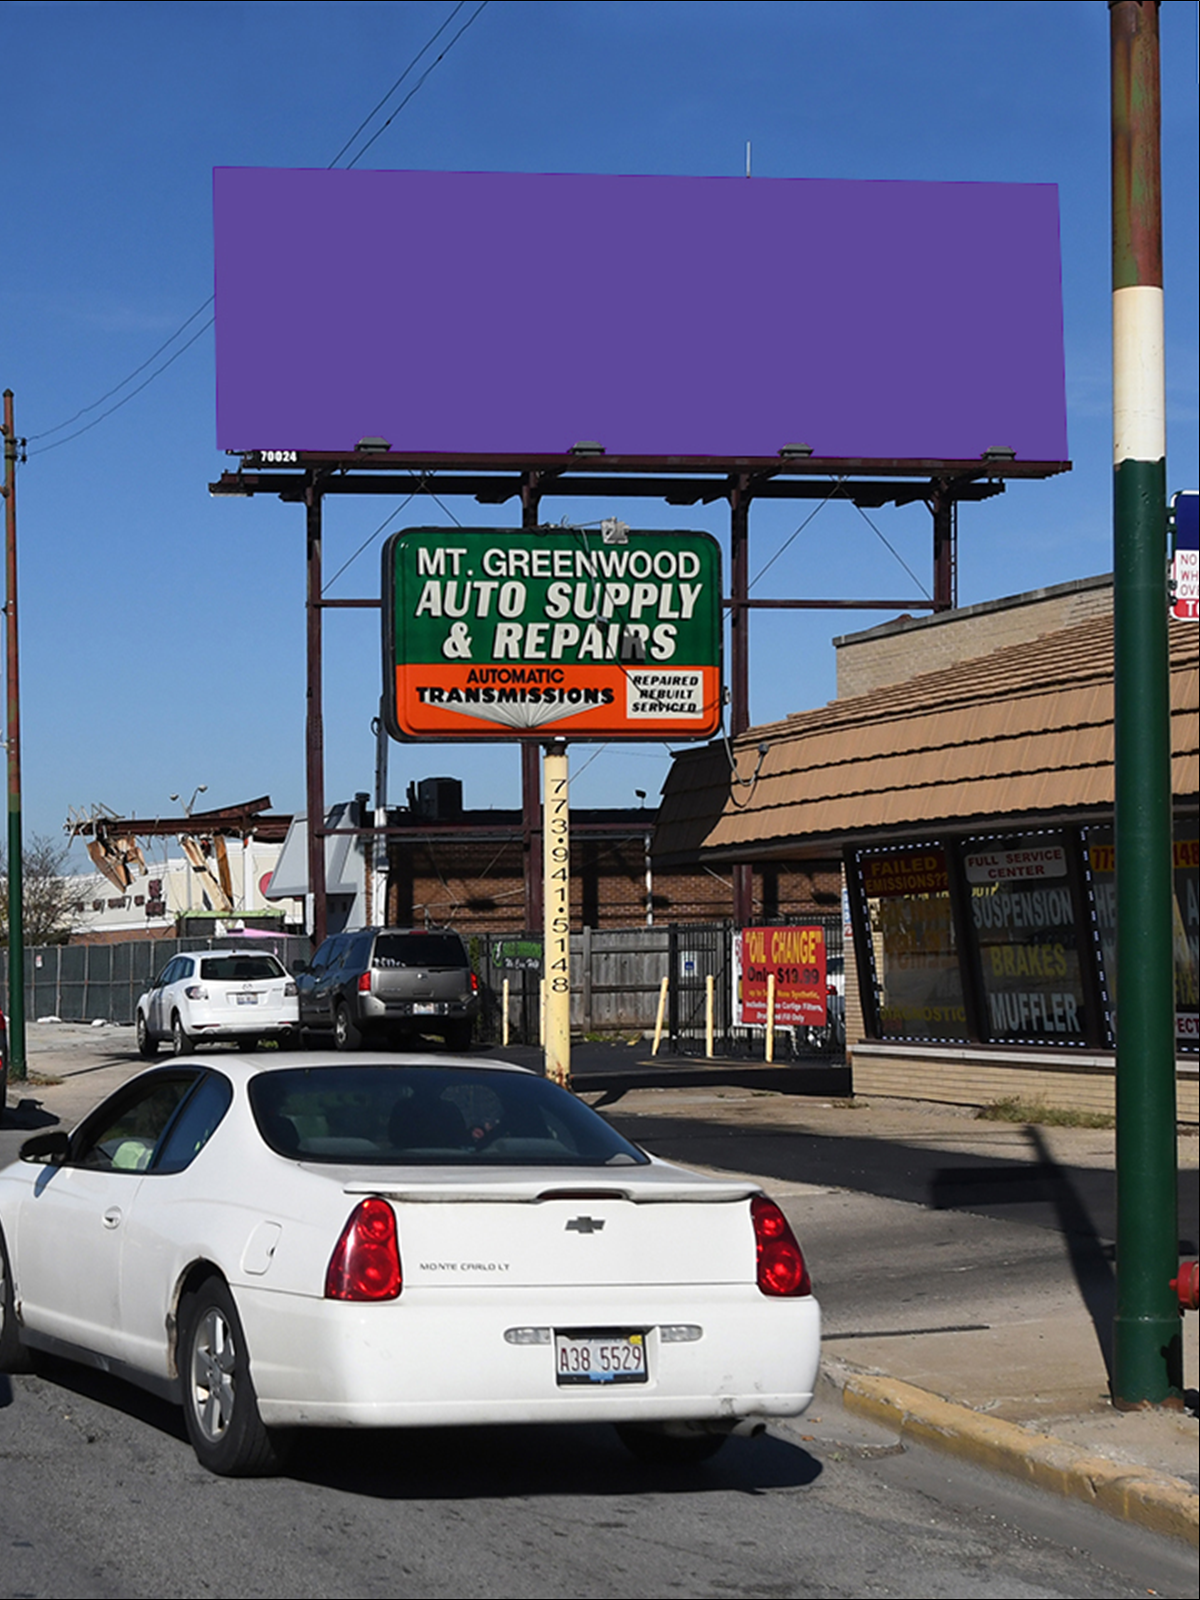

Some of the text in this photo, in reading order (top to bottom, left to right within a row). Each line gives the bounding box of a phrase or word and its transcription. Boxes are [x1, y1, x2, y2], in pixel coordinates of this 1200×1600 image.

[260, 450, 298, 463] 70024
[416, 547, 701, 580] MT. GREENWOOD
[1180, 554, 1198, 566] NO
[415, 580, 703, 620] AUTO SUPPLY
[442, 621, 678, 661] & REPAIRS
[467, 668, 565, 685] AUTOMATIC
[632, 675, 700, 687] REPAIRED
[415, 686, 615, 705] TRANSMISSIONS
[639, 689, 695, 700] REBUILT
[631, 702, 698, 714] SERVICED
[870, 856, 938, 876] FAILED
[967, 848, 1062, 867] FULL SERVICE
[987, 865, 1045, 879] CENTER
[970, 888, 1075, 930] SUSPENSION
[989, 943, 1068, 978] BRAKES
[879, 1005, 967, 1022] DIAGNOSTIC
[989, 992, 1082, 1033] MUFFLER
[419, 1262, 511, 1272] MONTE CARLO LT
[560, 1345, 643, 1372] A38 5529
